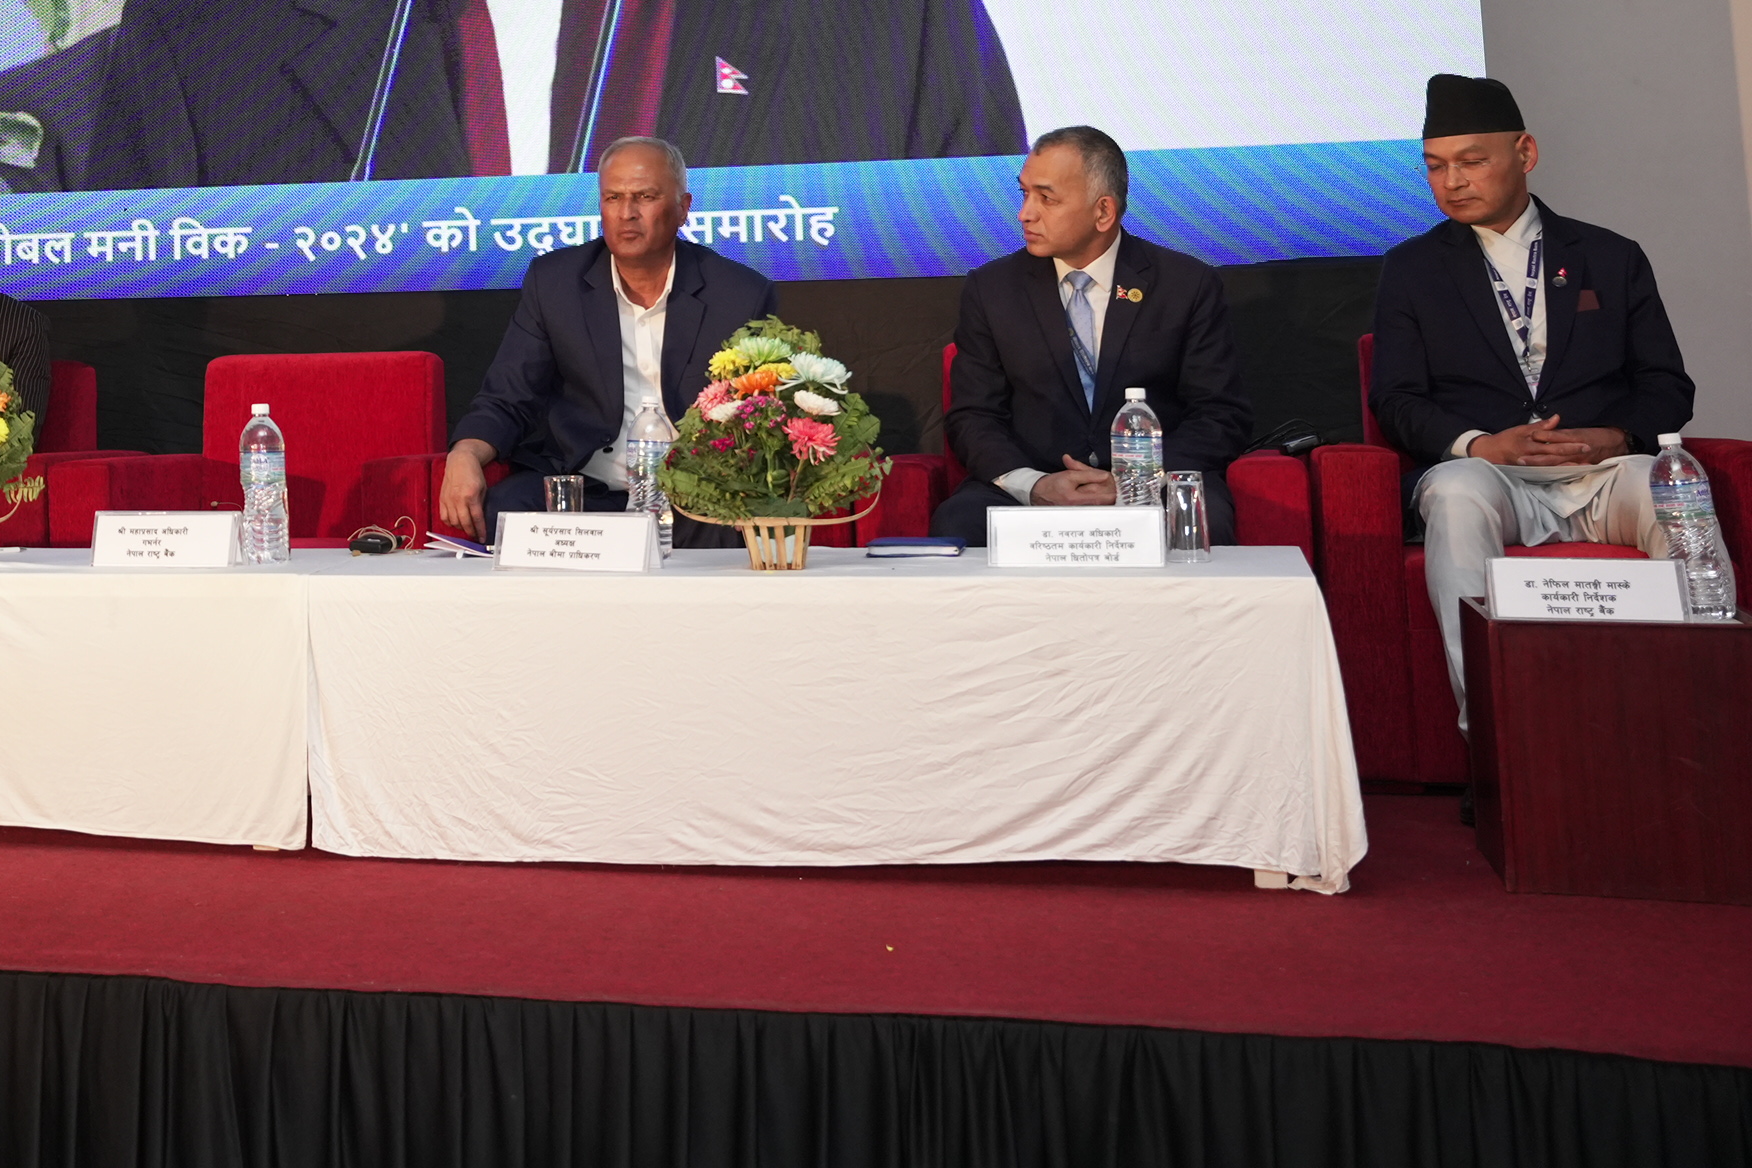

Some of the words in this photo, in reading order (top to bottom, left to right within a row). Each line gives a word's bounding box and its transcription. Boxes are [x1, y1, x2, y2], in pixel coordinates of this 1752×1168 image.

[82, 219, 159, 262] मनी
[169, 217, 253, 260] विक
[423, 206, 481, 252] को
[678, 194, 839, 246] समारोह
[162, 527, 188, 535] अधिकारी
[530, 525, 538, 534] श्री
[575, 526, 603, 536] सिलवाल
[1089, 528, 1121, 538] अधिकारी
[1069, 540, 1101, 550] कार्यकारी
[1106, 540, 1135, 550] निर्देशक
[127, 549, 143, 557] नेपाल
[527, 548, 545, 557] नेपाल
[550, 549, 565, 558] बीमा
[569, 550, 600, 560] प्राधिकरण
[1046, 553, 1066, 562] नेपाल
[1524, 580, 1537, 588] डा.
[1543, 579, 1569, 589] नेफिल
[1607, 580, 1631, 590] मास्के
[1541, 591, 1578, 602] कार्यकारी
[1584, 592, 1616, 602] निर्देशक
[1547, 604, 1570, 614] नेपाल
[1576, 607, 1594, 617] राष्ट्र
[1599, 604, 1615, 615] बैंक
